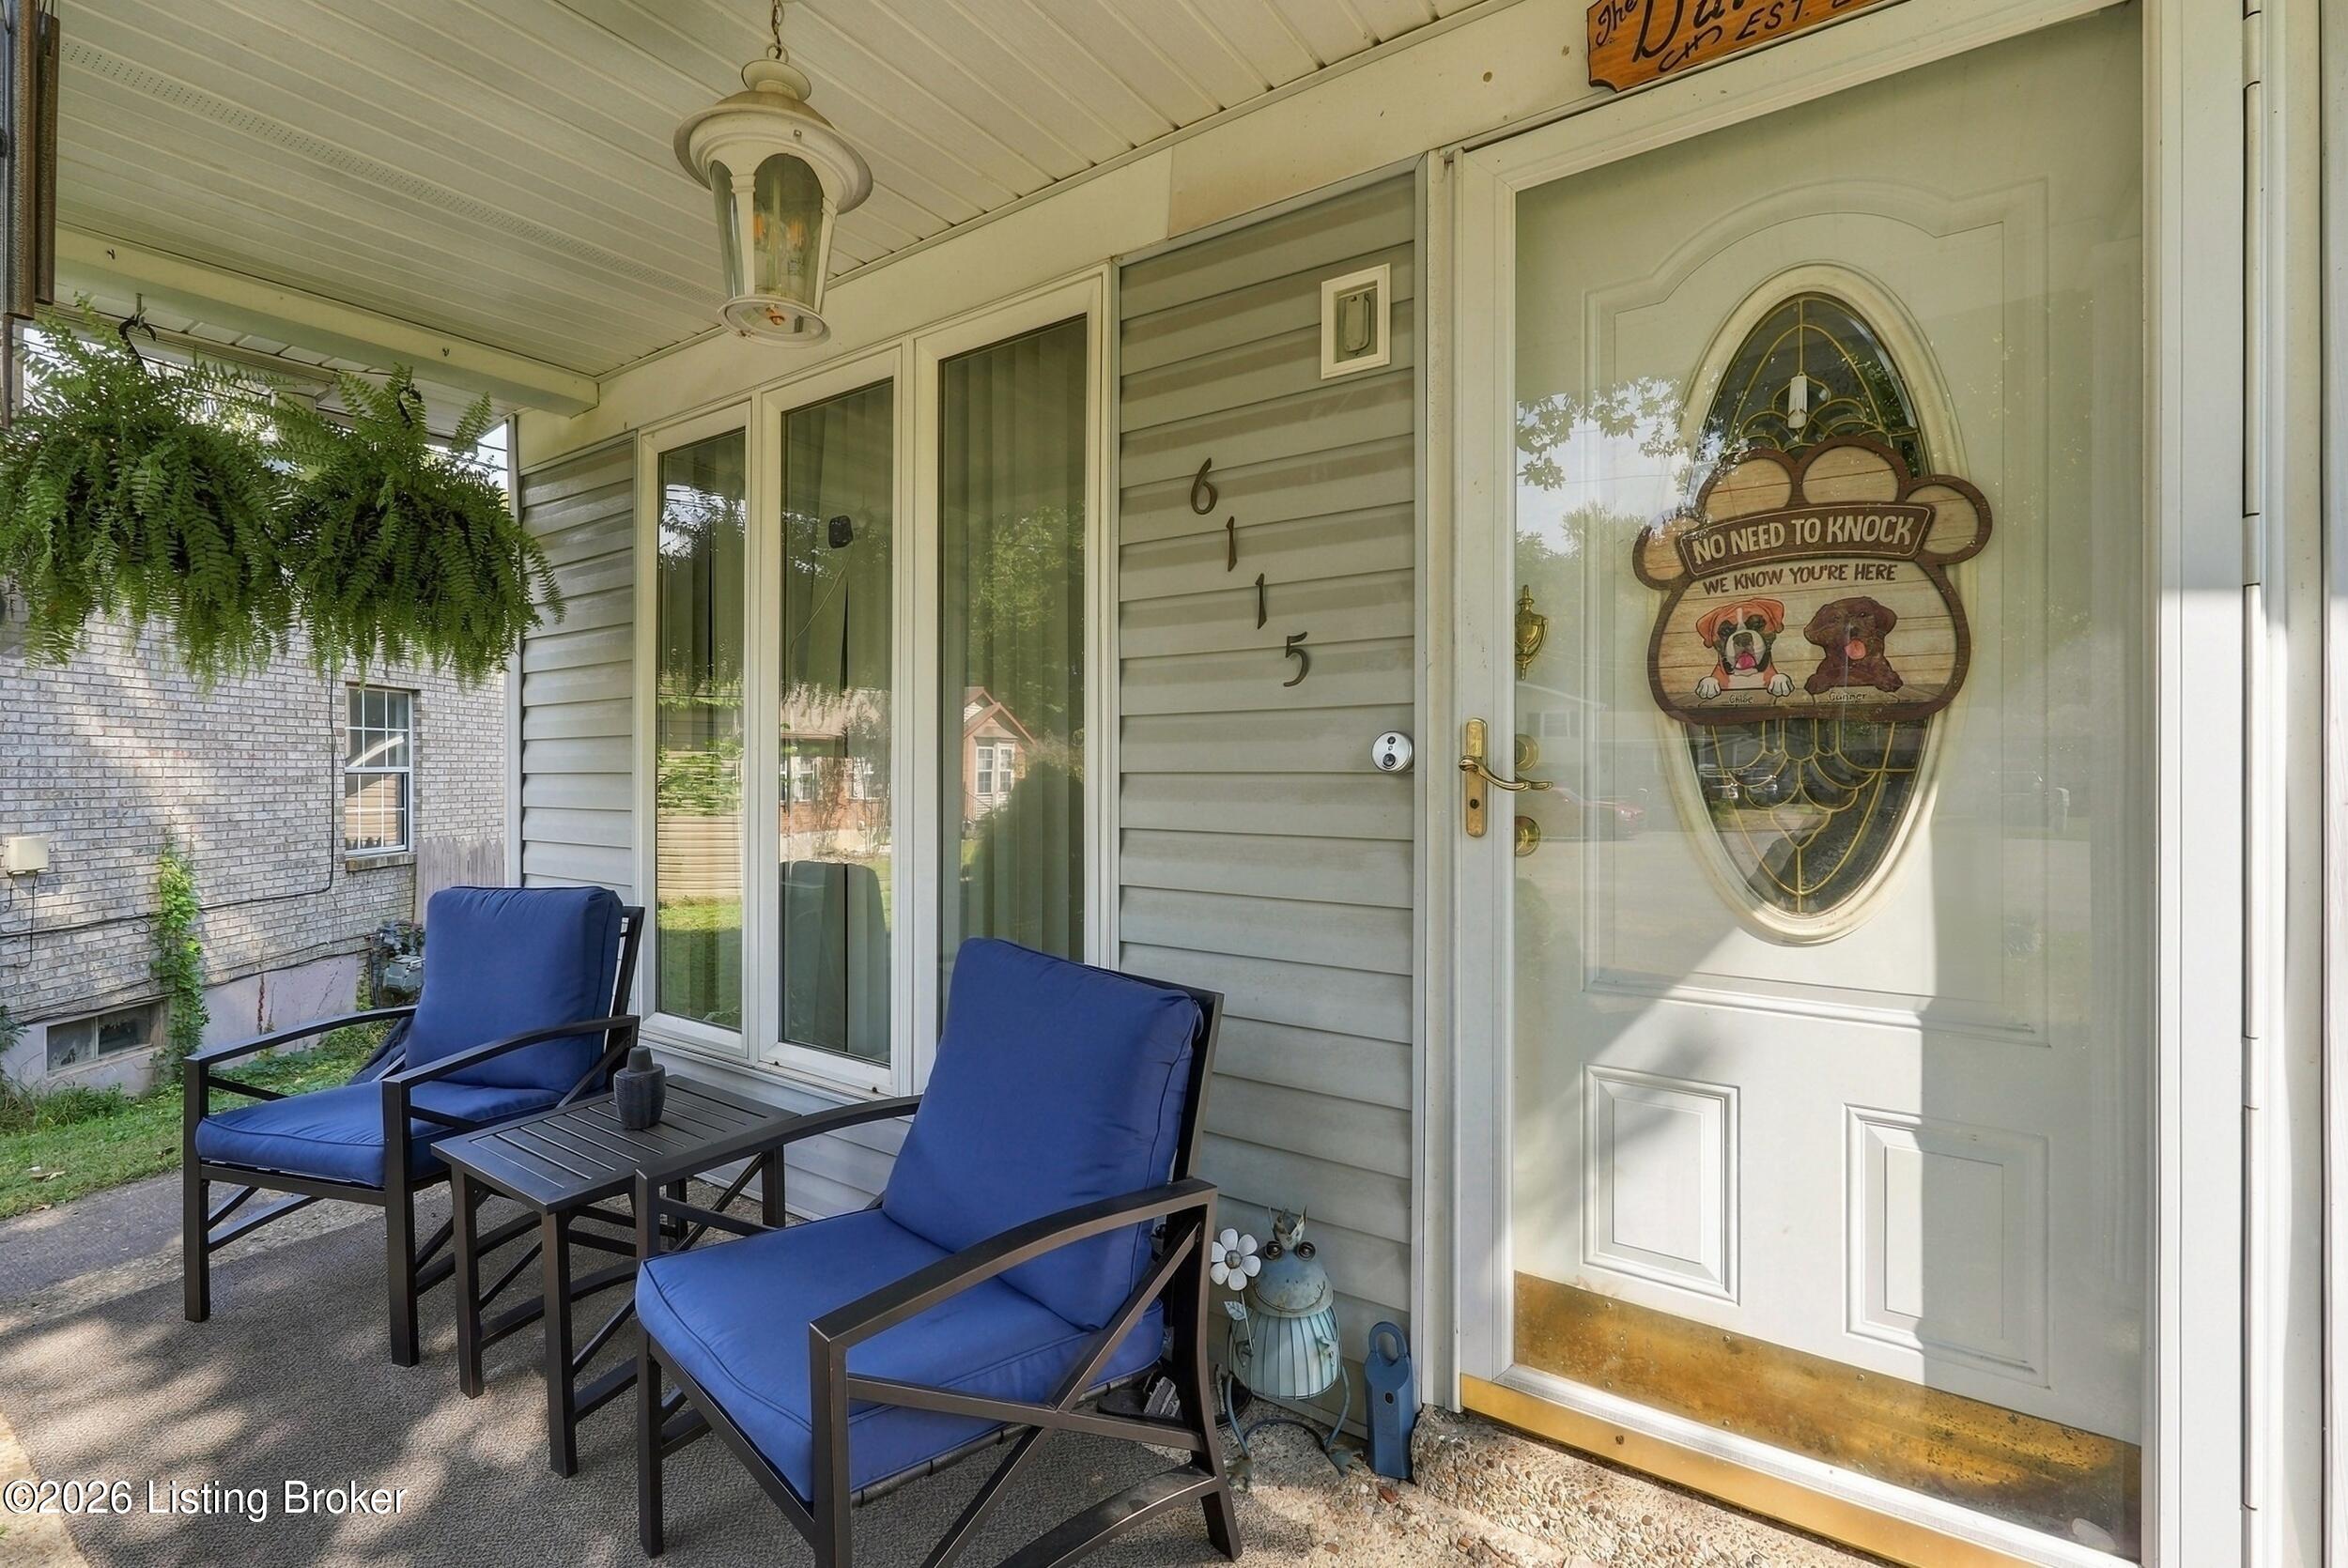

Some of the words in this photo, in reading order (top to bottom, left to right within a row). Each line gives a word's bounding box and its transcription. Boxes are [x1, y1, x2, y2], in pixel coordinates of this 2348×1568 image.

[1596, 0, 1638, 46] The
[1691, 533, 1726, 565] NO
[1730, 522, 1785, 556] NEED
[1791, 517, 1821, 546] TO
[1827, 515, 1915, 546] KNOCK
[1190, 457, 1310, 687] 6115
[1703, 576, 1728, 595] WE
[1734, 568, 1784, 592] KNOW
[1788, 563, 1849, 584] YOU'RE
[1854, 563, 1898, 581] HERE
